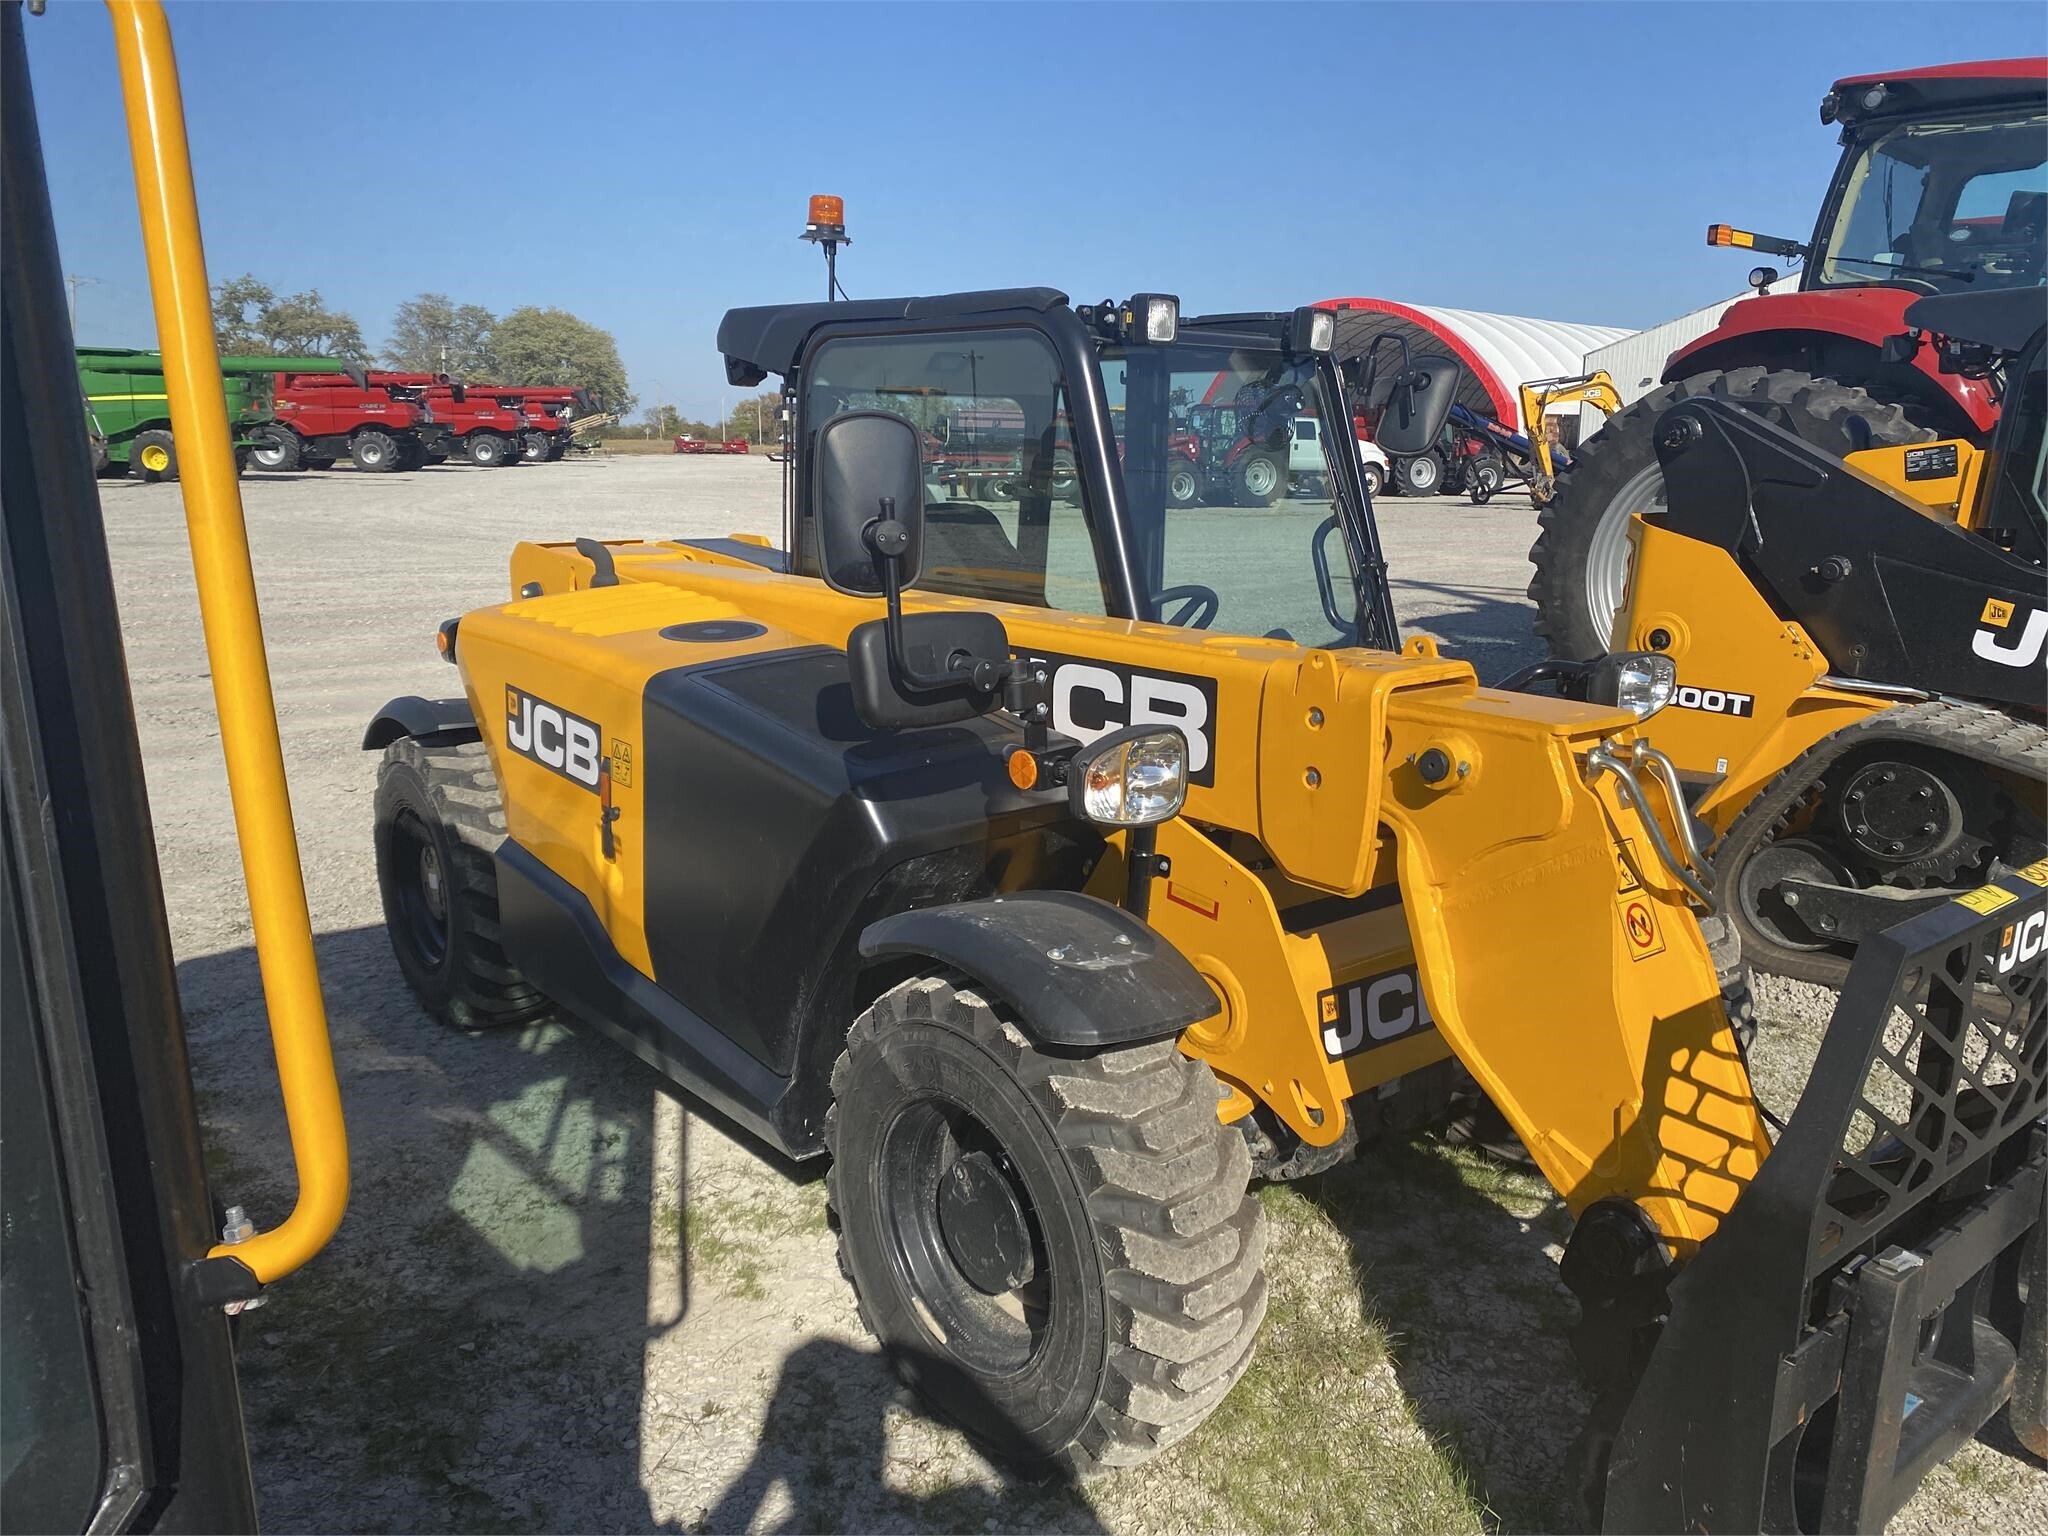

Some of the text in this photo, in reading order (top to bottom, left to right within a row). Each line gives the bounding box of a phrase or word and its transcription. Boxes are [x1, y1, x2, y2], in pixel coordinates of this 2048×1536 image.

[1584, 390, 1602, 398] JCB
[1028, 657, 1209, 772] CB
[1669, 686, 1751, 715] 00T
[507, 697, 599, 786] JCB
[1998, 910, 2048, 974] JC
[1323, 969, 1433, 1056] JC
